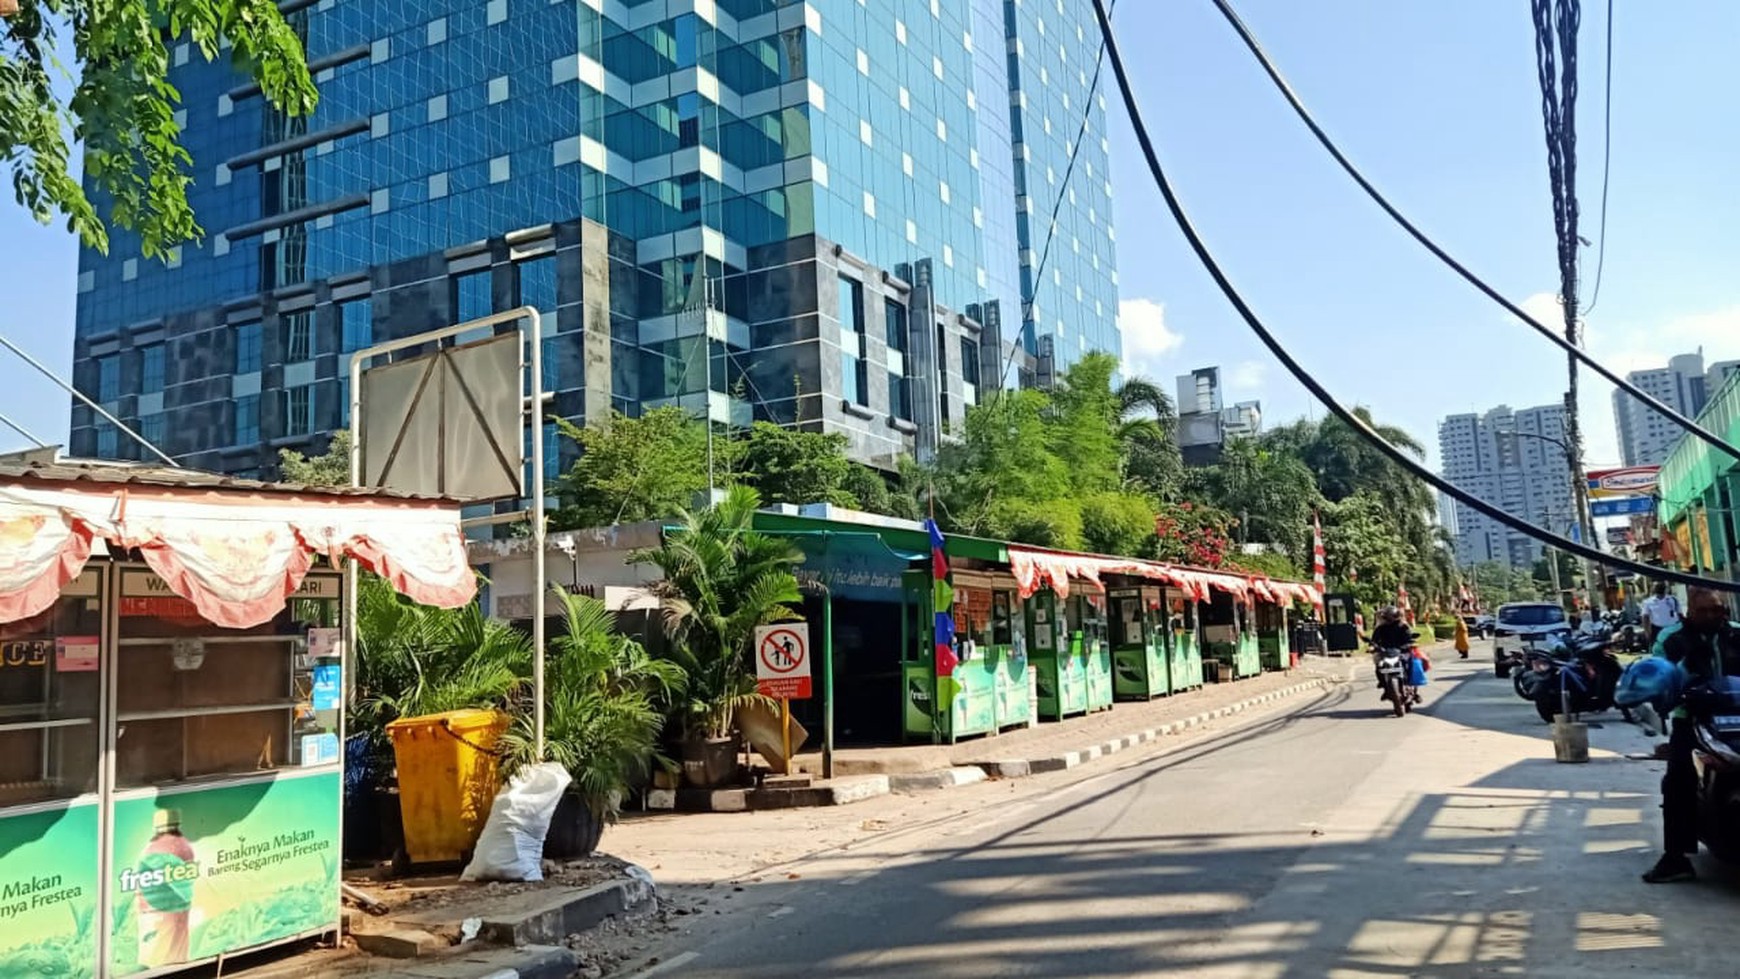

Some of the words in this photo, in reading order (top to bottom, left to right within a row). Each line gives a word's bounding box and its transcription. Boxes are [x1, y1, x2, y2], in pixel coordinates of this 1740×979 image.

[296, 581, 322, 595] ARI
[0, 640, 47, 666] CE
[207, 860, 241, 877] Bareng
[241, 847, 291, 872] Segarnya
[292, 839, 330, 859] Frestea
[216, 838, 270, 864] Enaknya
[272, 828, 316, 849] Makan
[2, 874, 62, 900] Makan
[120, 861, 199, 893] frestea
[32, 886, 82, 909] Frestea
